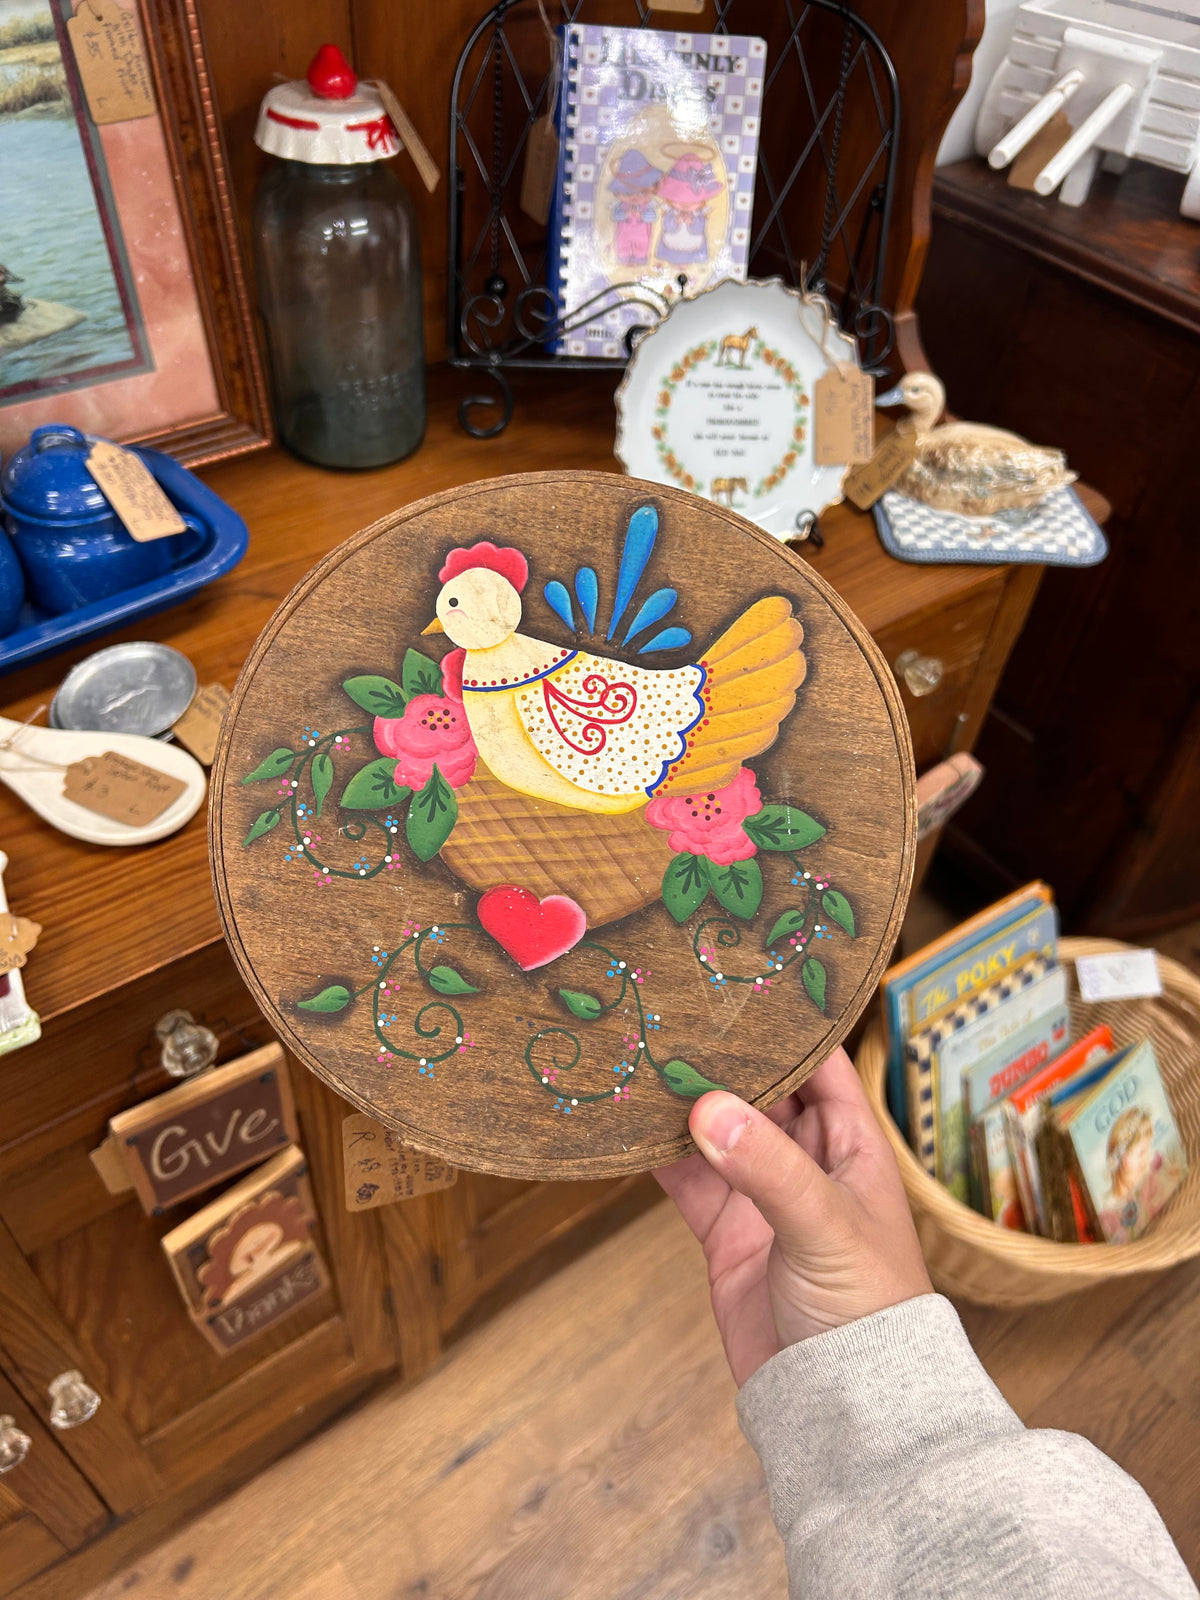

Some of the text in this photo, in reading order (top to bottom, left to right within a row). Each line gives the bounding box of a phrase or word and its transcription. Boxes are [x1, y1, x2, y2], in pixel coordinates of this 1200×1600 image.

[955, 940, 1017, 997] POKY
[1094, 1074, 1138, 1136] GOD
[348, 1130, 377, 1150] R
